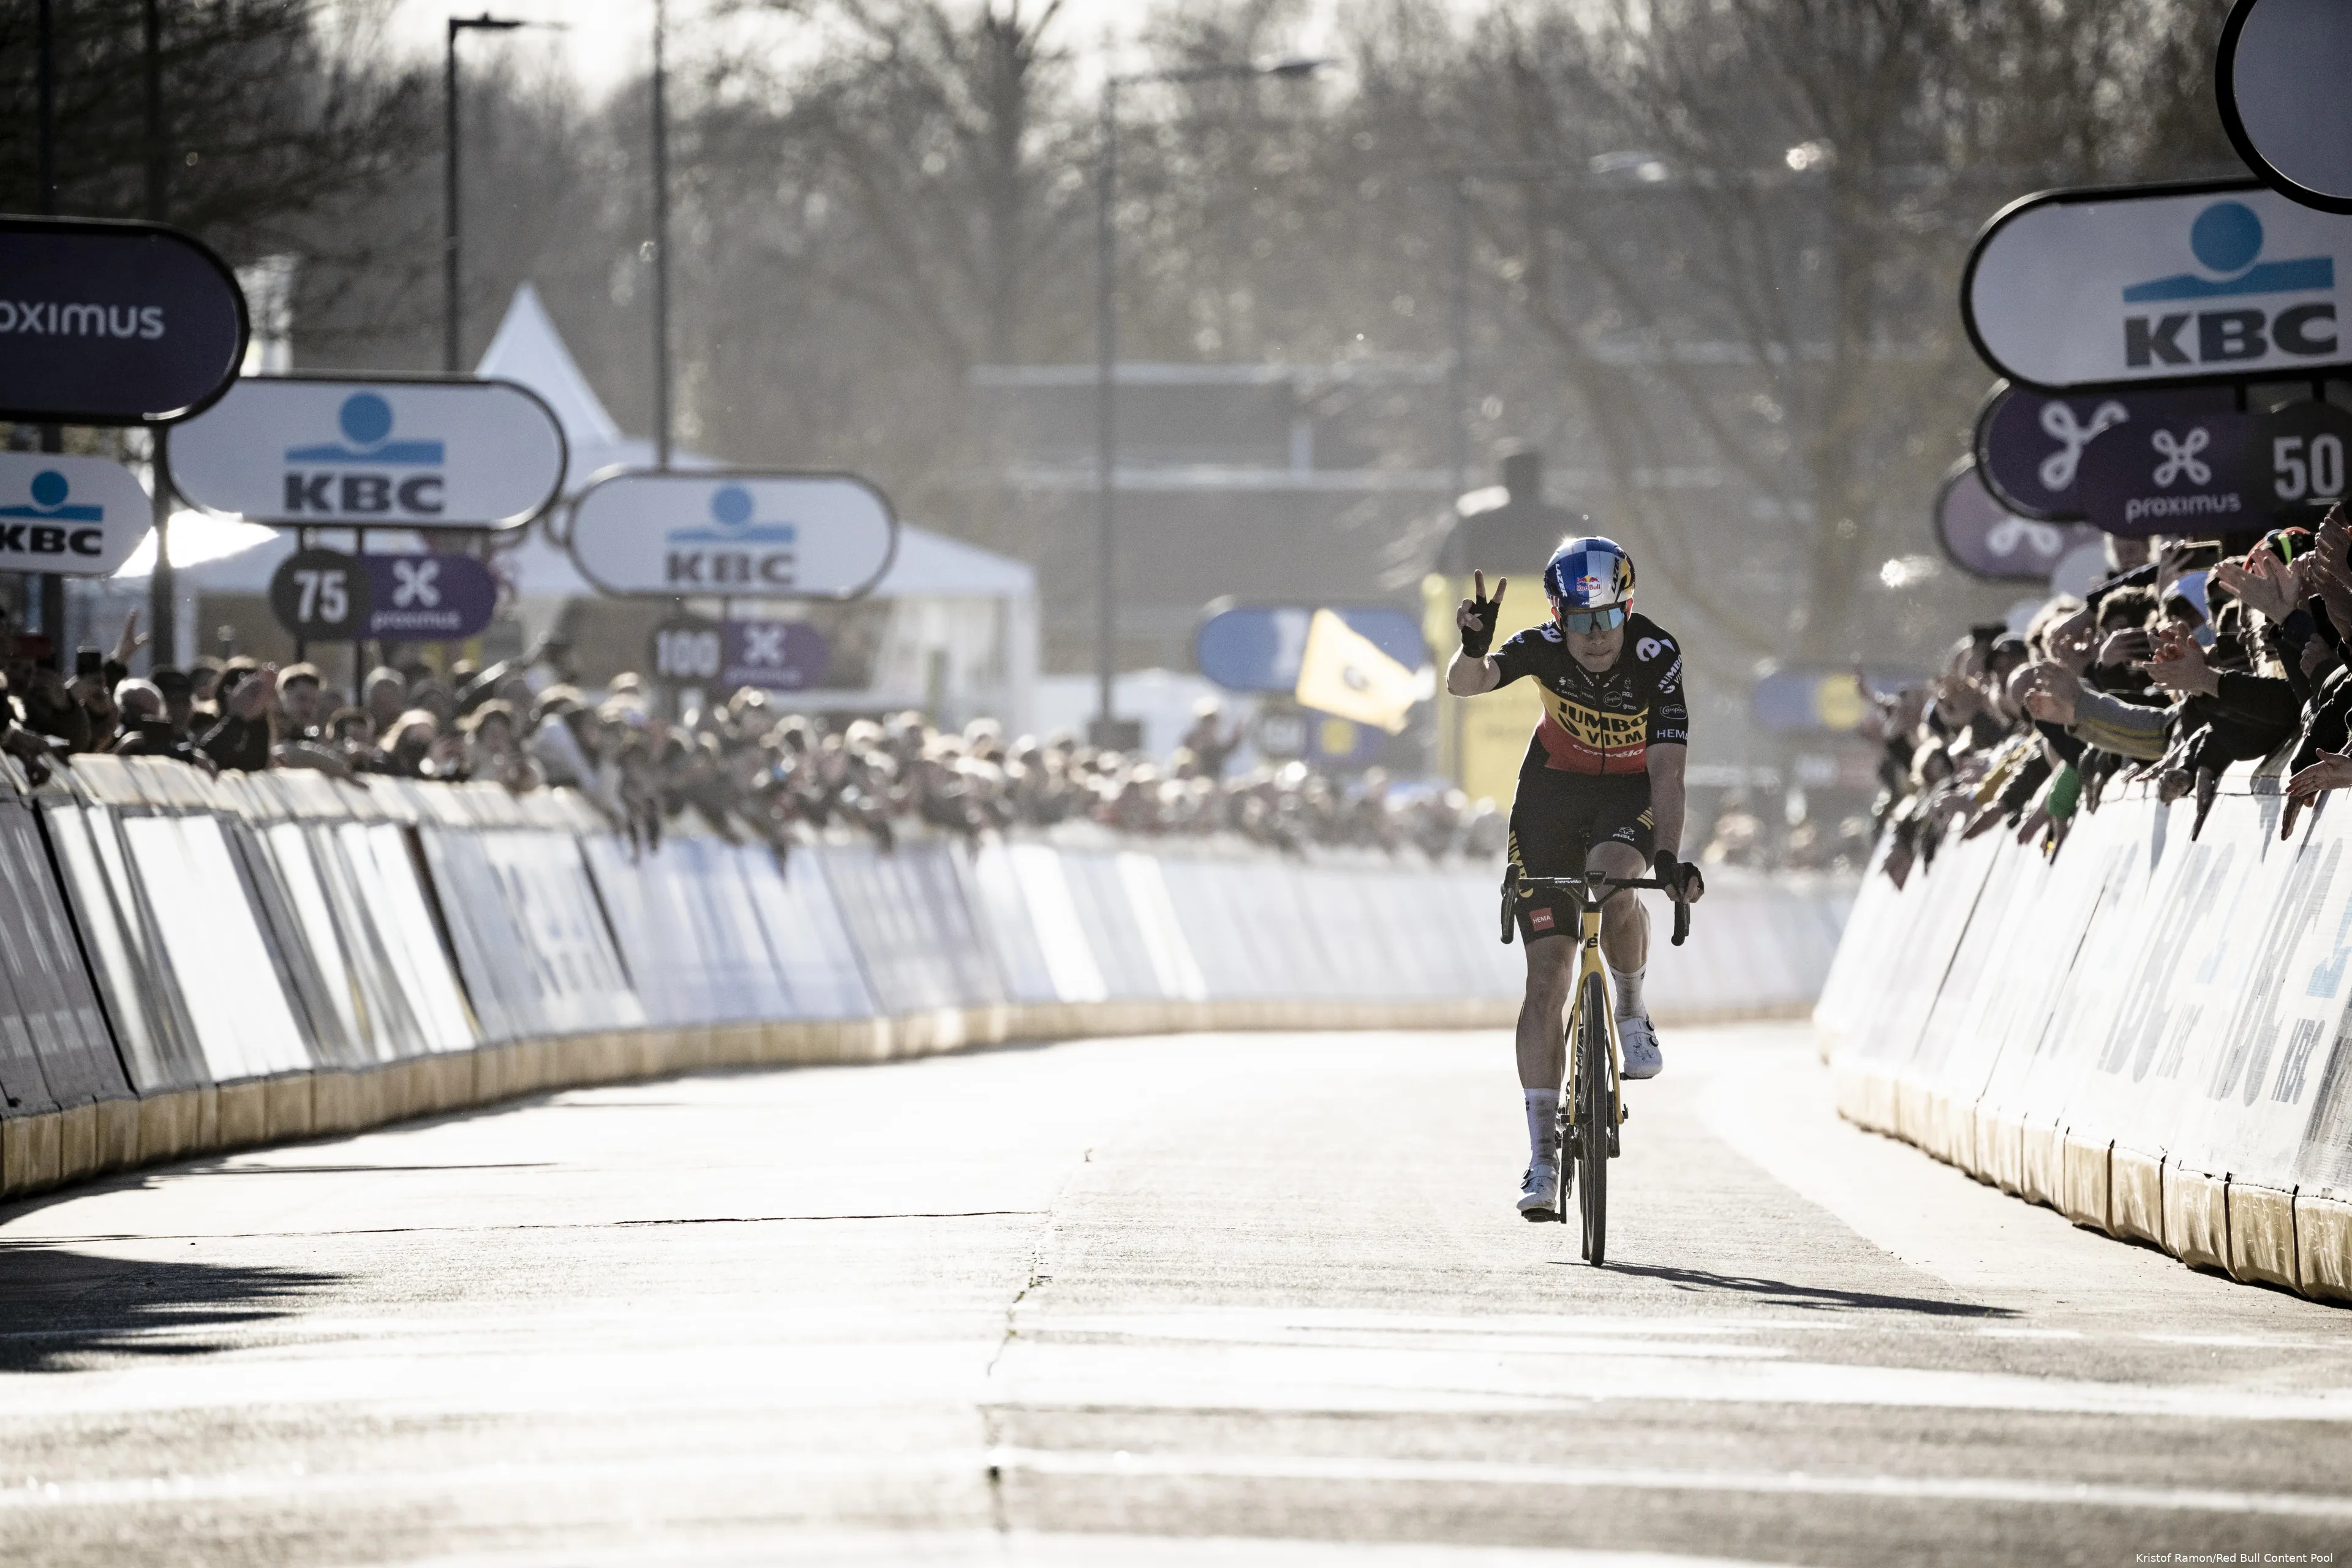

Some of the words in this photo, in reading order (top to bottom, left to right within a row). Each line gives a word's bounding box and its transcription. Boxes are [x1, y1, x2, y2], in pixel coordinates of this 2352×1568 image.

[2124, 303, 2337, 369] KBC
[2273, 432, 2345, 500] 50
[284, 470, 447, 515] KBC
[2125, 492, 2241, 524] proximus
[0, 524, 104, 557] KBC
[666, 549, 797, 585] KBC
[1555, 563, 1568, 598] LAZER
[294, 568, 349, 622] 75
[369, 611, 460, 633] proximus
[657, 630, 721, 679] 100
[1657, 654, 1683, 690] JUMBO
[1558, 701, 1648, 732] JUMBO
[1573, 744, 1645, 758] cervélo
[1586, 730, 1645, 745] VISM
[1657, 729, 1688, 740] HEMA
[1532, 914, 1551, 924] HEMA
[2270, 1017, 2326, 1106] KBC
